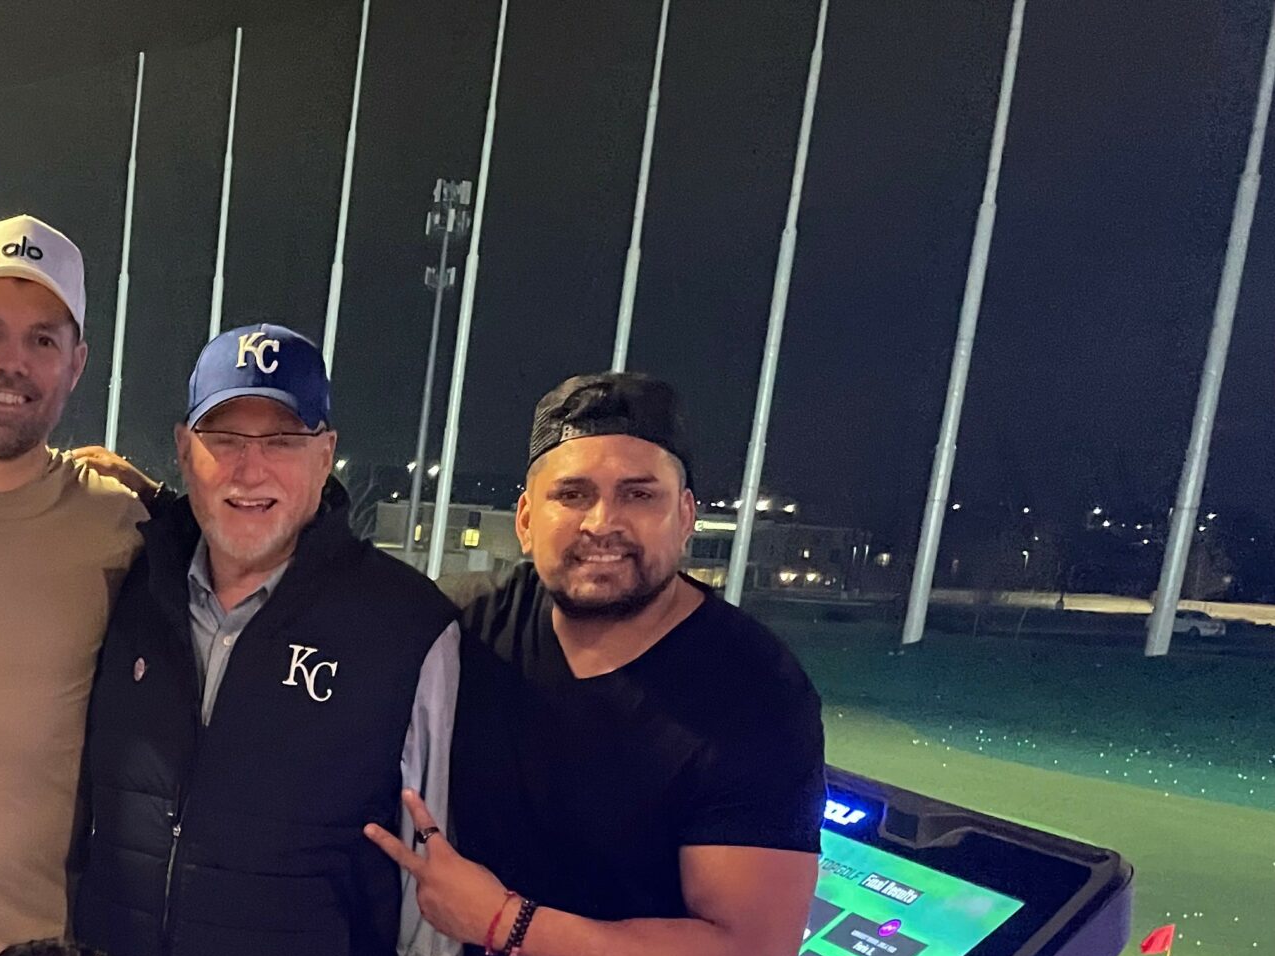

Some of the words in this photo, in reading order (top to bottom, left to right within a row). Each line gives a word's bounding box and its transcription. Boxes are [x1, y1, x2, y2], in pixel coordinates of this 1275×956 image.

[2, 236, 43, 260] alo
[235, 332, 279, 374] KC
[282, 644, 338, 702] KC
